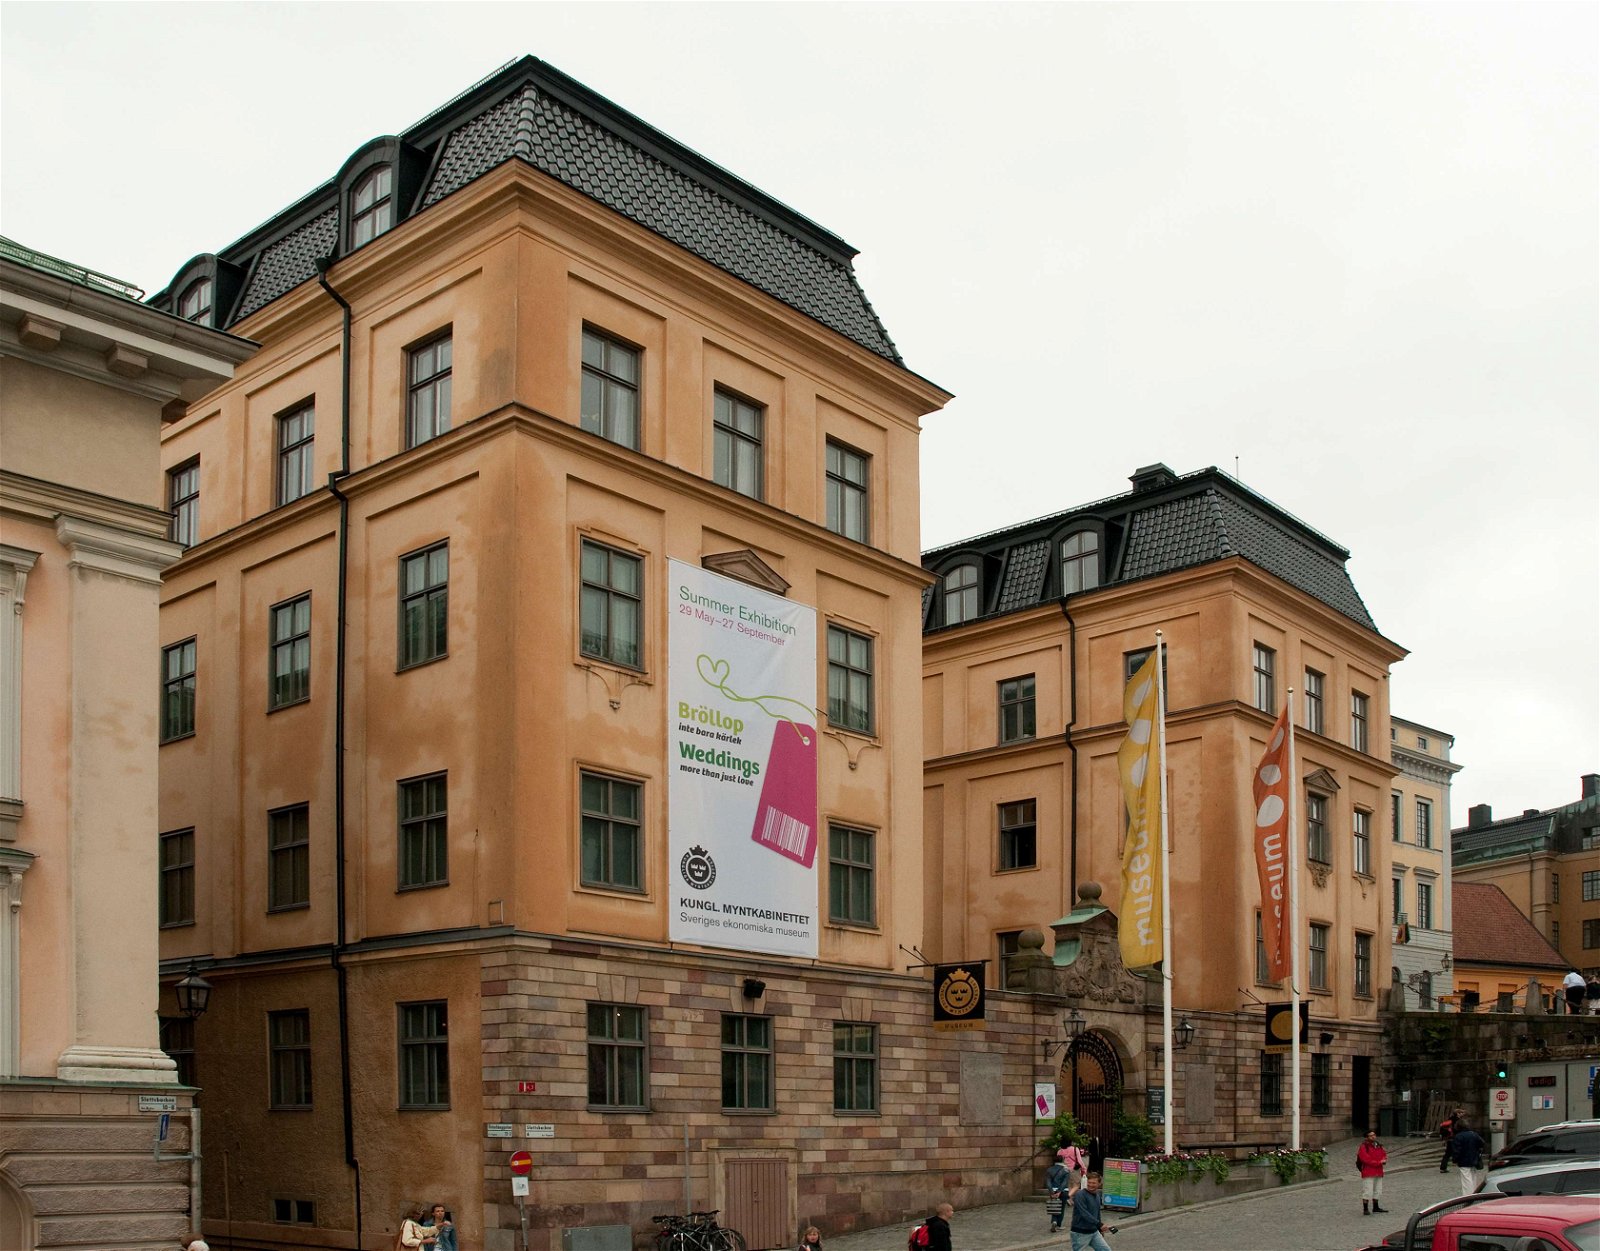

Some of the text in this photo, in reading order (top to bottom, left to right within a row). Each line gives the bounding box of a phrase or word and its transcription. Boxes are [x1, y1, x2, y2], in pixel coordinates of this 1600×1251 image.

[679, 585, 796, 636] Summer Exhibition
[679, 603, 693, 616] 29
[737, 621, 786, 647] September
[678, 701, 744, 735] Bröllop
[678, 721, 742, 745] inte bara kärlek
[678, 741, 760, 779] Weddings
[680, 763, 754, 787] more than just love
[680, 897, 810, 926] KUNGL. MYNTKABINETTET
[1263, 833, 1284, 966] seum
[680, 911, 810, 939] Sveriges ekonomiska museum
